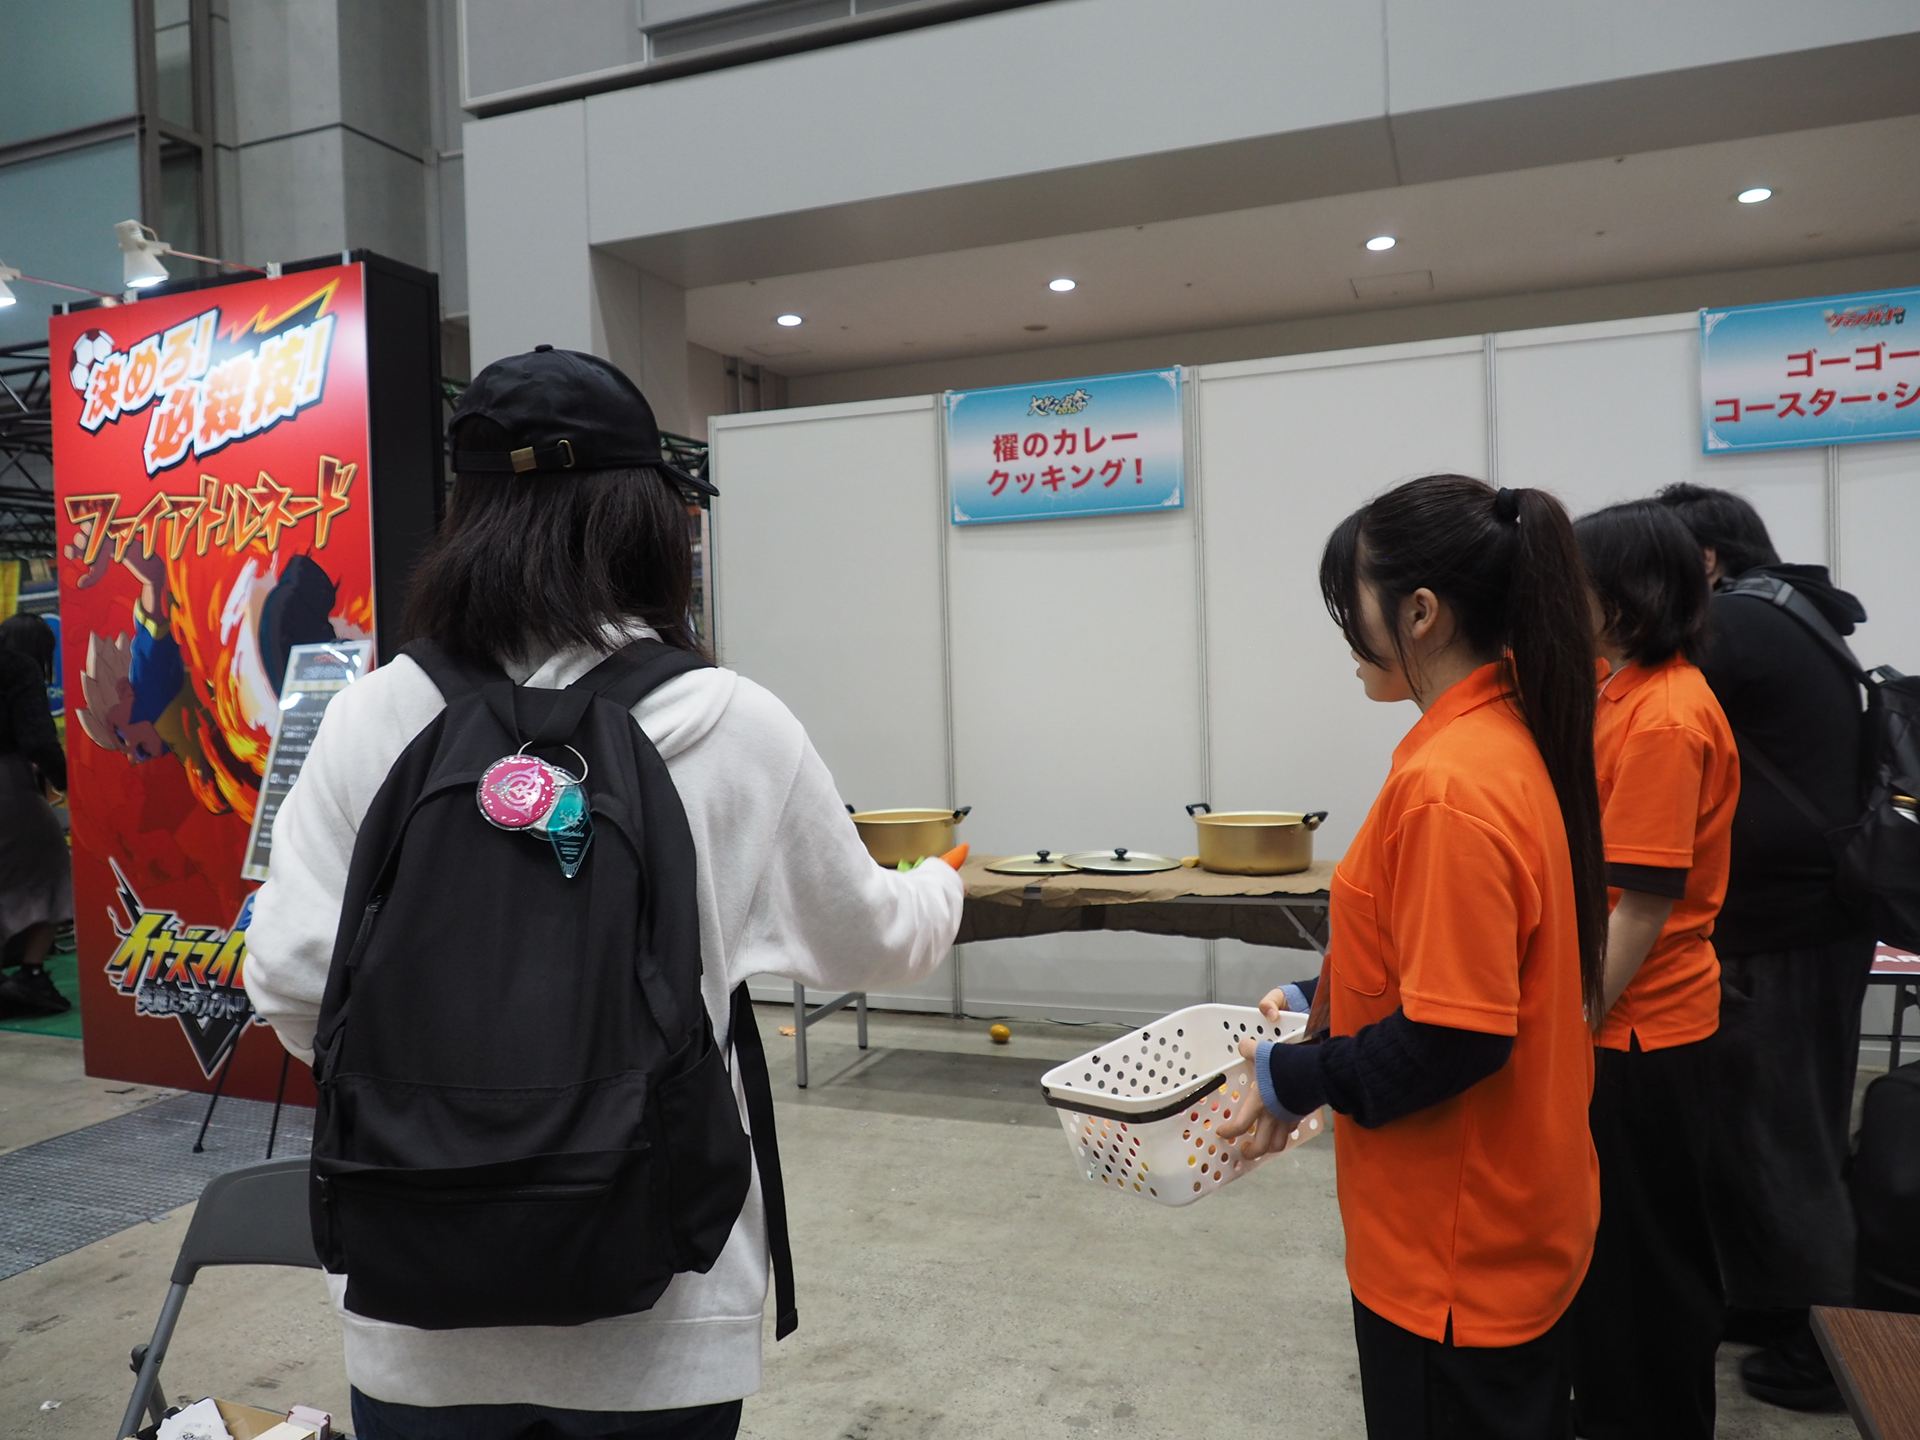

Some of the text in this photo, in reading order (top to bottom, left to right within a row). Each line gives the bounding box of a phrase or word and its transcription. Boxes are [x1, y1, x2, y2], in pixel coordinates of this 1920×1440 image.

[1786, 341, 1920, 377] ゴーゴー
[992, 427, 1138, 463] 櫂のカレー
[986, 457, 1143, 497] クッキング！
[64, 455, 358, 565] ファイアトルネード
